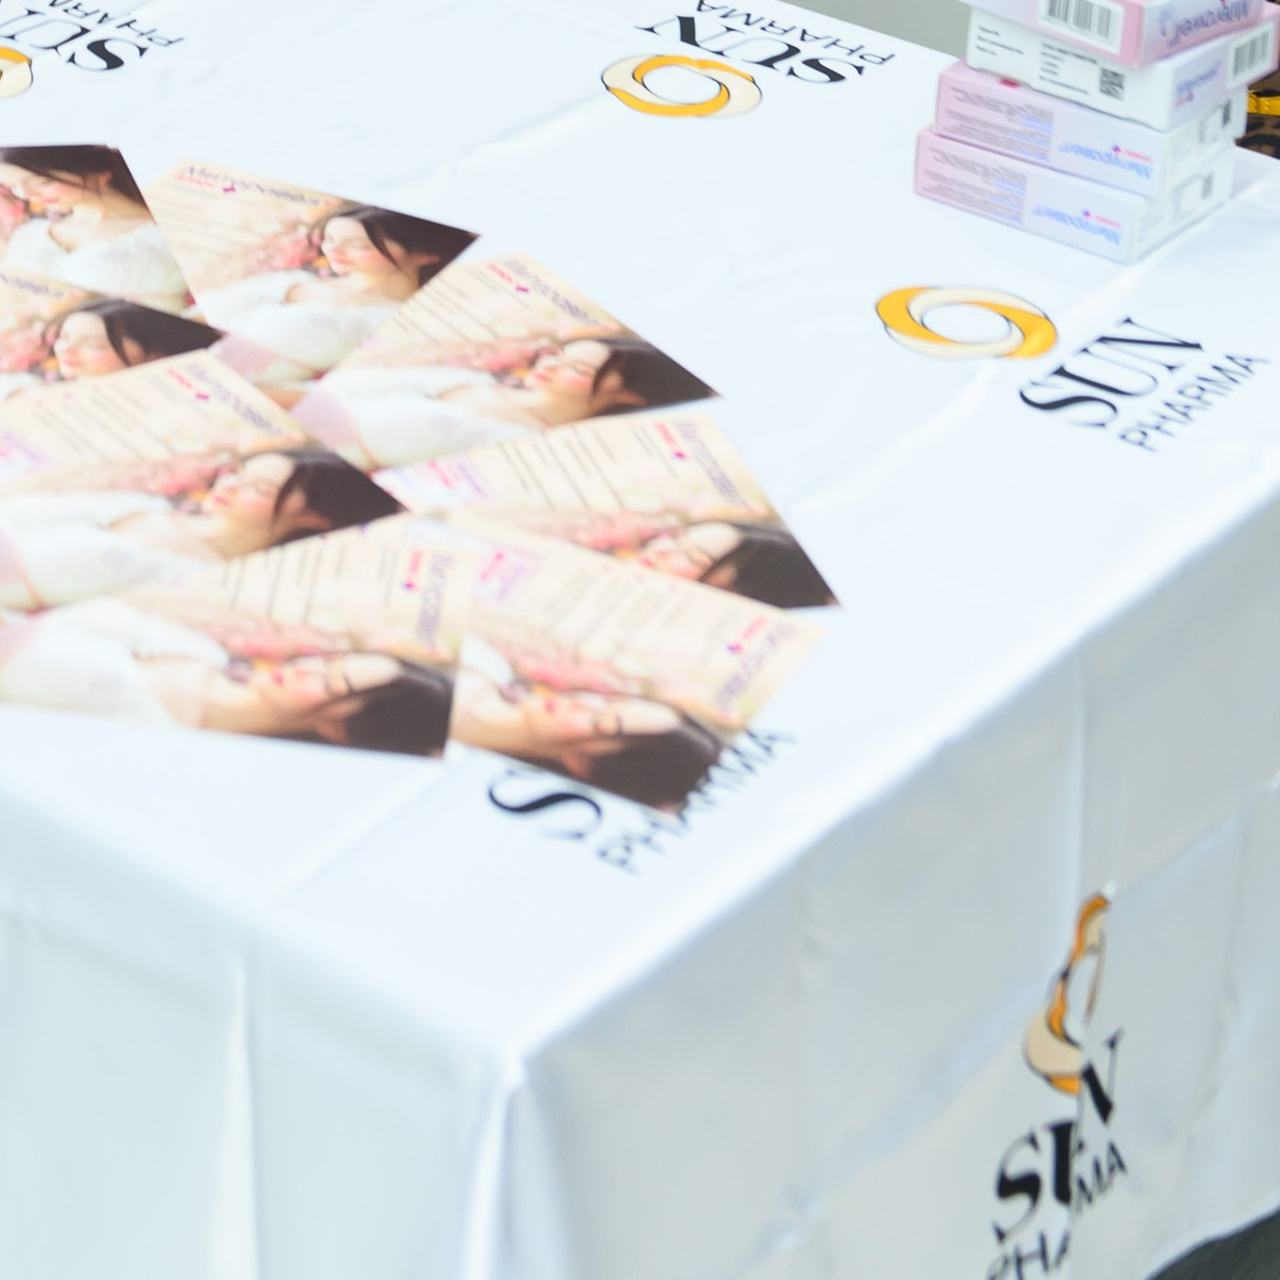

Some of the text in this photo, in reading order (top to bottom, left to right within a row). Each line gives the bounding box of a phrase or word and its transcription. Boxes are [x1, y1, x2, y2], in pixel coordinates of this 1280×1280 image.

[635, 15, 867, 84] SUN
[1019, 317, 1203, 428] SUN
[1118, 351, 1270, 454] PHARMA
